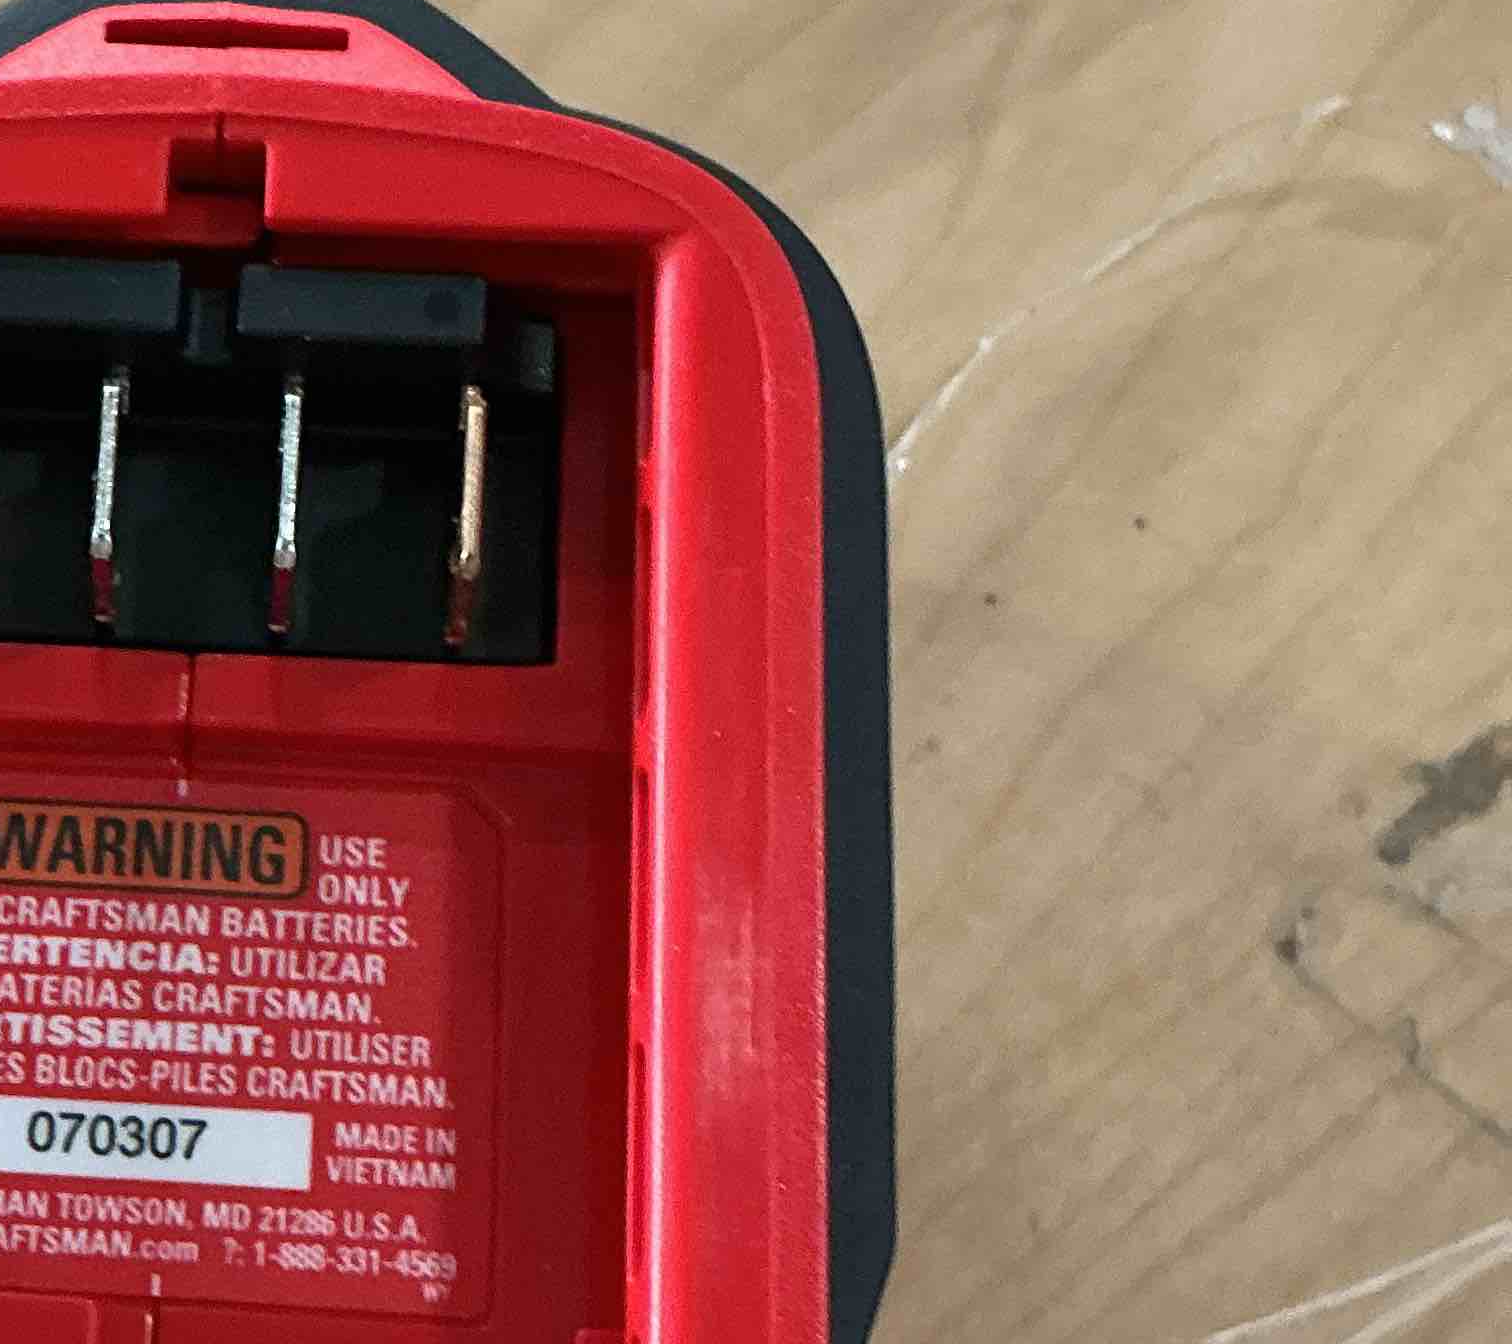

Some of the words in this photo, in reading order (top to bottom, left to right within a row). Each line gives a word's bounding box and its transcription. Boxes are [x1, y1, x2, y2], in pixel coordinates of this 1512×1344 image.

[320, 835, 386, 868] USE
[318, 873, 409, 907] ONLY
[221, 906, 419, 947] BATTERIES.
[231, 946, 386, 986] UTILIZAR
[153, 980, 382, 1024] CRAFTSMAN.
[290, 1029, 430, 1068] UTILISER
[34, 1053, 237, 1096] BLOCS-PILES
[247, 1066, 453, 1110] CRAFTSMAN.
[28, 1110, 208, 1160] 070307
[335, 1122, 417, 1153] MADE
[425, 1127, 456, 1155] IN
[326, 1156, 455, 1190] VIETNAM
[203, 1201, 251, 1231] MD
